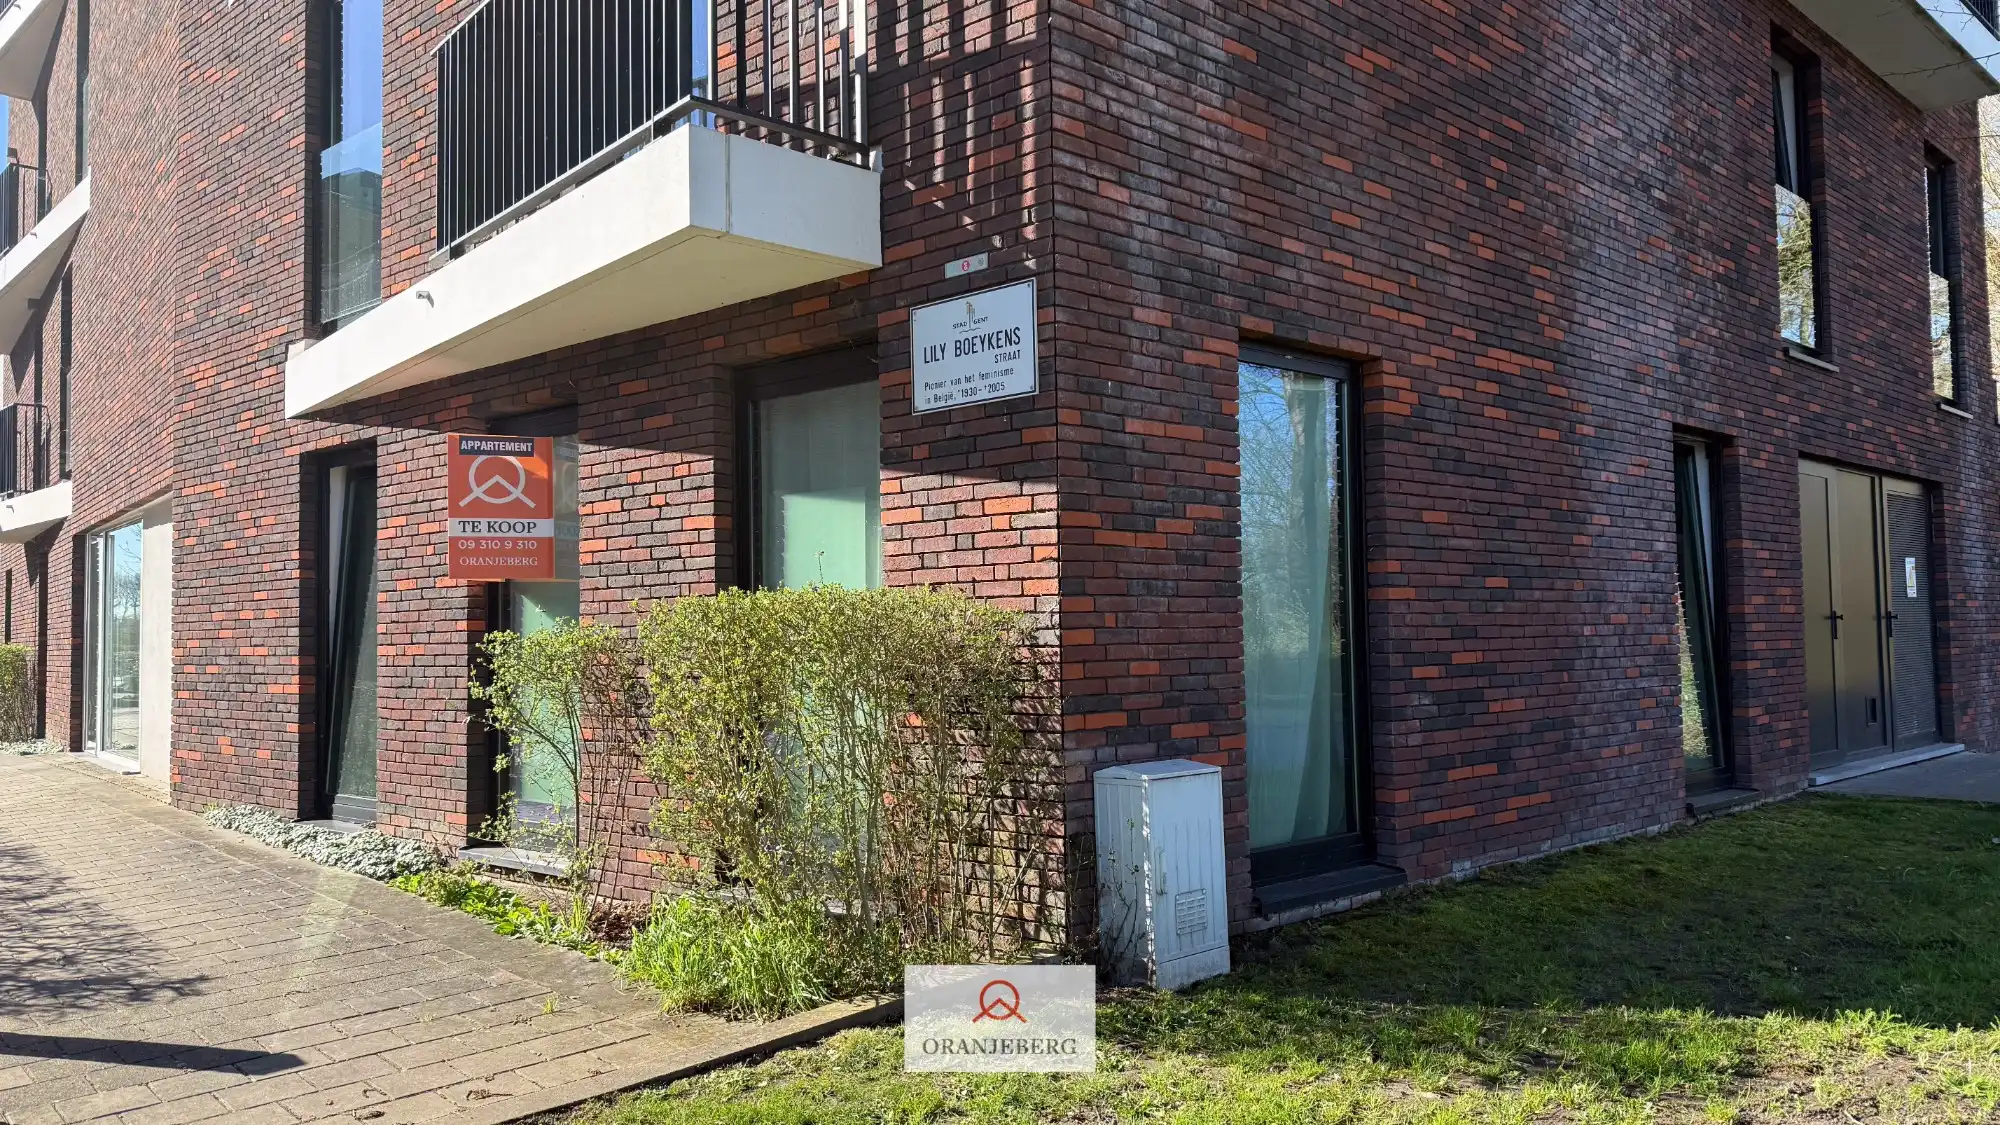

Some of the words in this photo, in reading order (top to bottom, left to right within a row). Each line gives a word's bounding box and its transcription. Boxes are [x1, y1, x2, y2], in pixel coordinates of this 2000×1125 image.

[952, 321, 968, 330] STAD
[973, 316, 989, 325] GENT
[924, 342, 947, 364] LILY
[954, 326, 1021, 358] BOEYKENS
[994, 349, 1021, 364] STRAAT
[924, 380, 947, 391] Pionier
[950, 376, 962, 386] van
[964, 373, 975, 383] het
[978, 367, 1014, 380] feminisme
[460, 440, 533, 452] APPARTEMENT
[458, 520, 482, 533] TE
[486, 520, 537, 534] KOOP
[458, 540, 475, 550] 09
[479, 540, 501, 550] 310
[504, 540, 513, 550] 9
[516, 540, 538, 550] 310
[459, 556, 538, 566] ORANJEBERG
